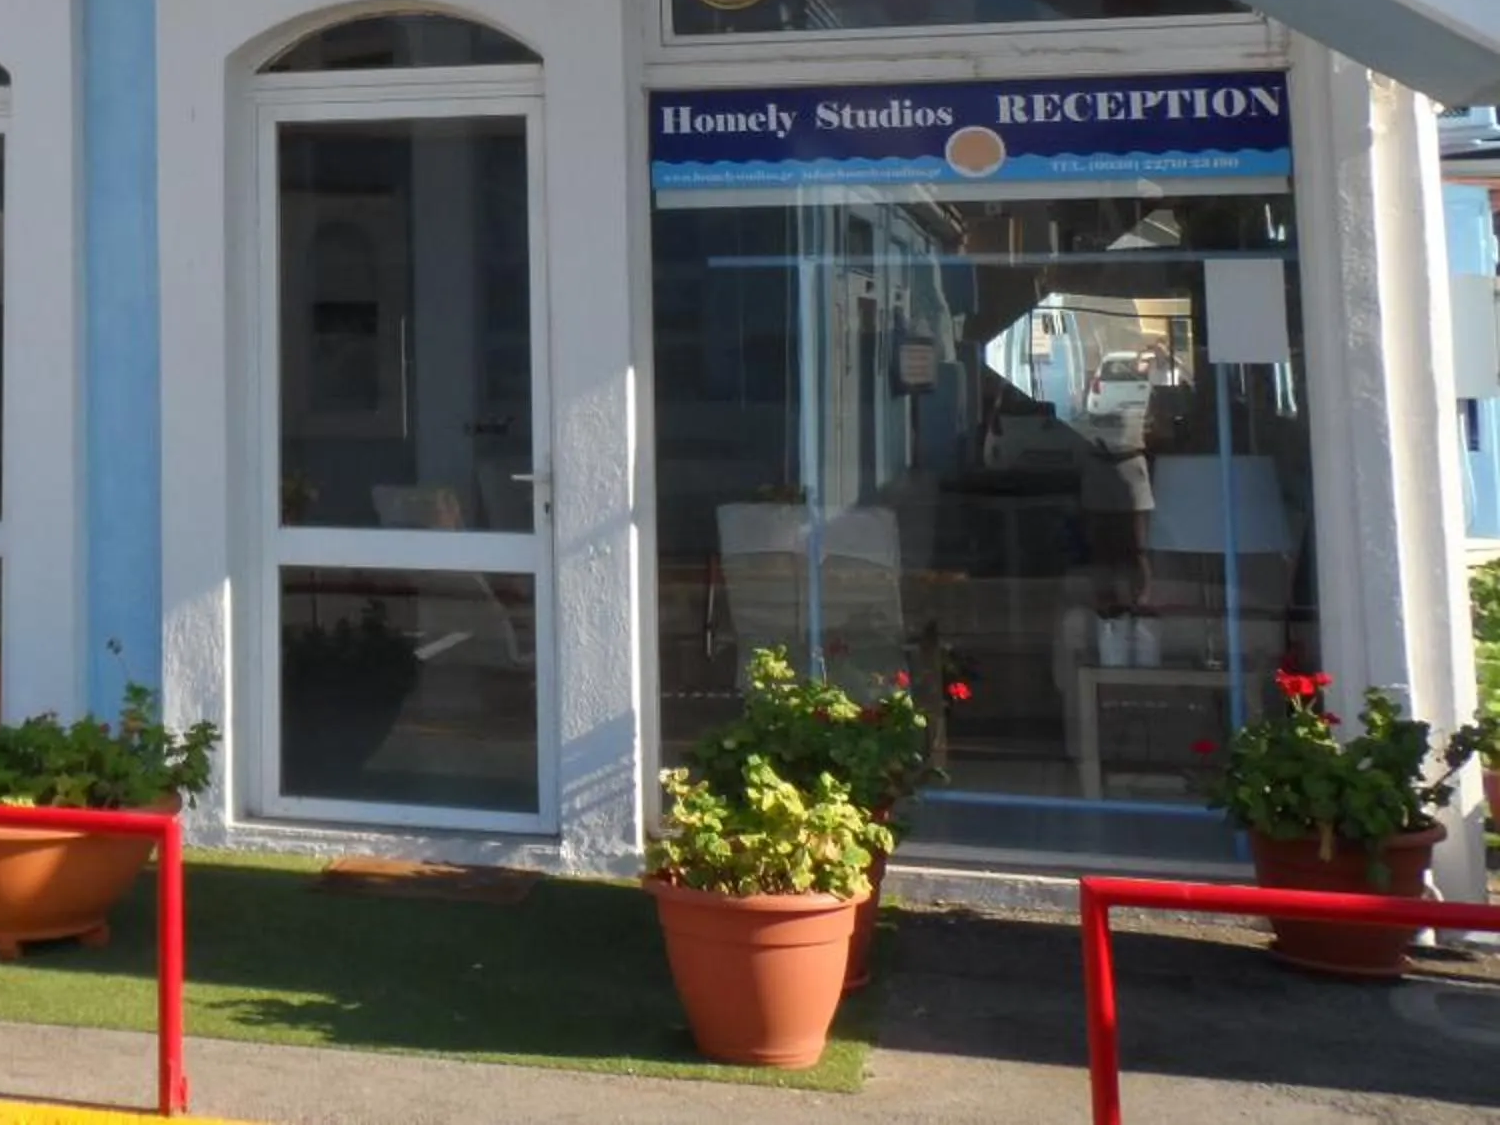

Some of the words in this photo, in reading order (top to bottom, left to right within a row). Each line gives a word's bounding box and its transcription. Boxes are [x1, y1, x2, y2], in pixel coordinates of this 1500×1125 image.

[661, 102, 797, 138] Homely
[815, 100, 953, 130] Studios
[996, 86, 1282, 124] RECEPTION
